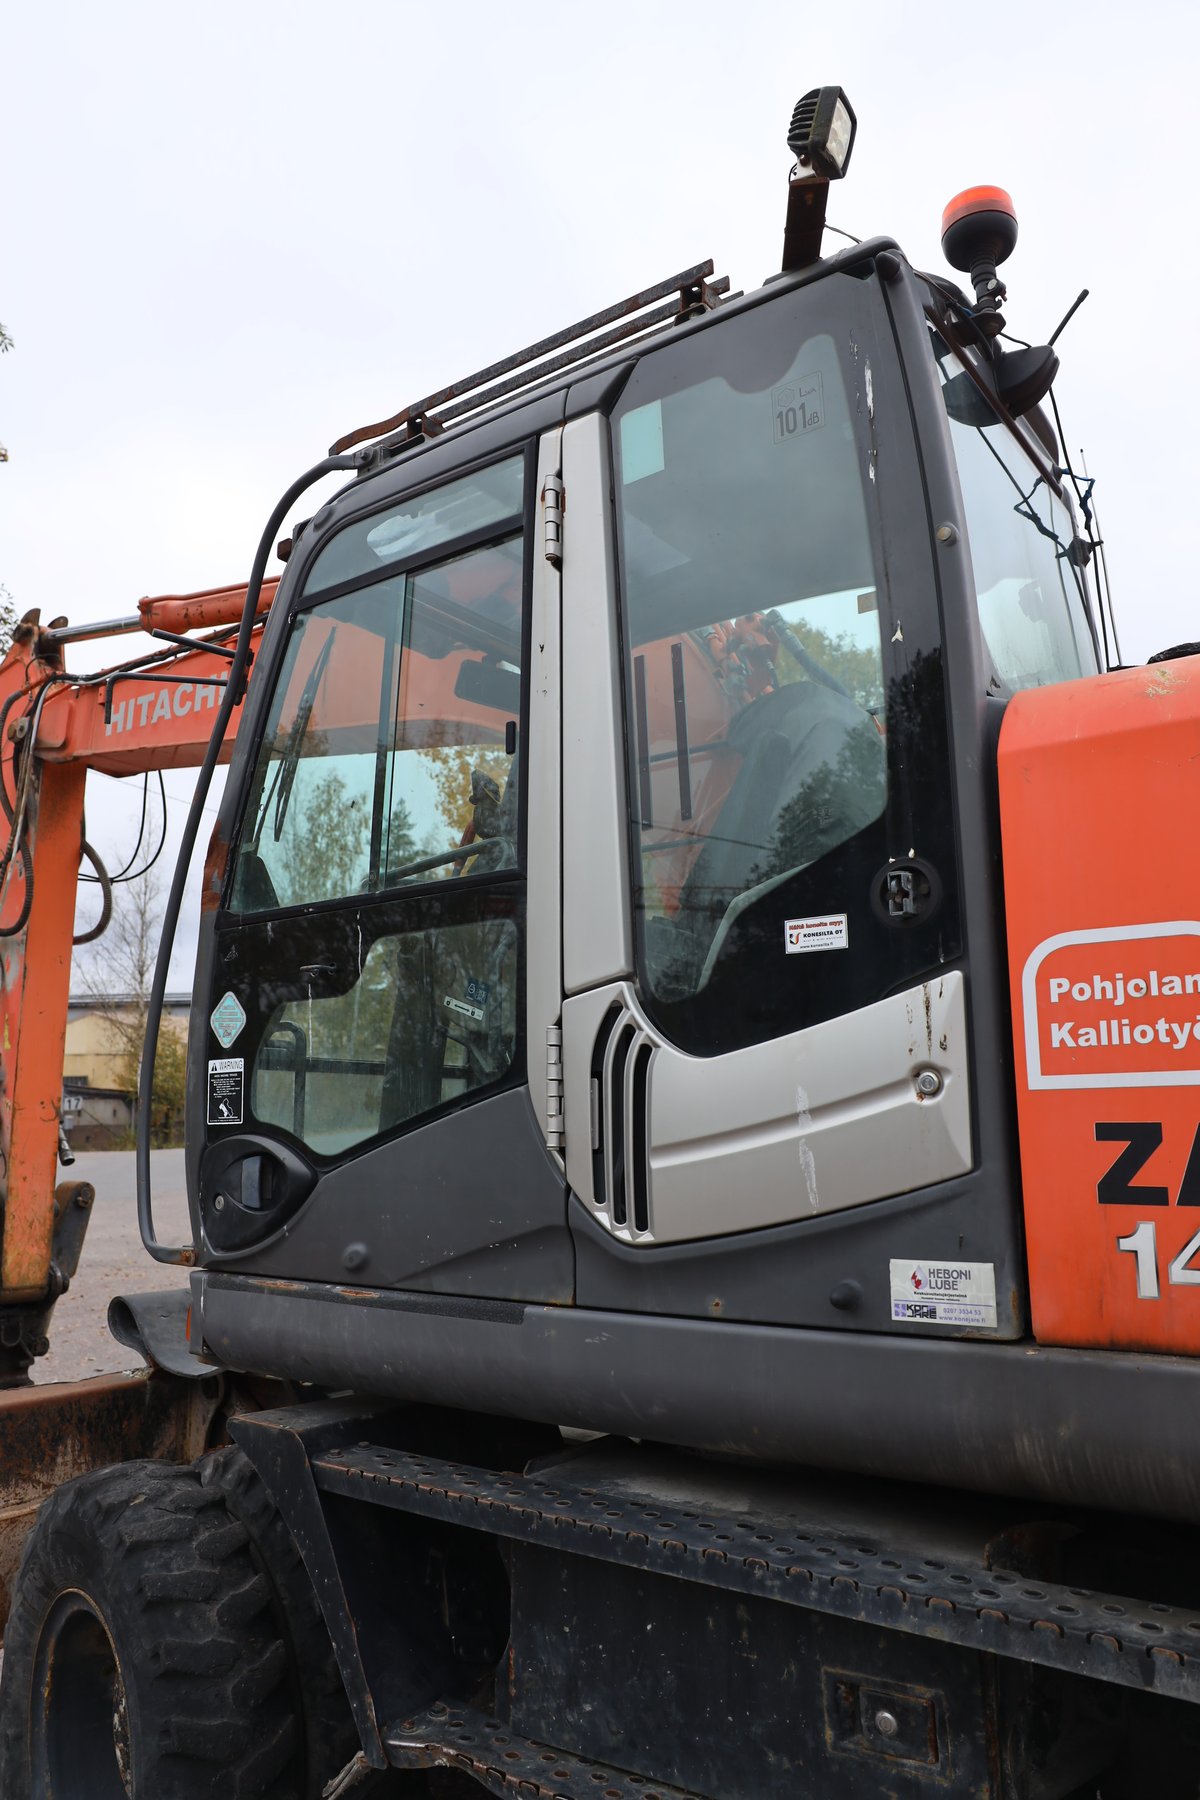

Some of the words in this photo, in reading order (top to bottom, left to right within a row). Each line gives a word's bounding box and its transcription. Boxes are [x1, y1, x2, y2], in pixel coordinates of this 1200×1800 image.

[776, 402, 807, 437] 101
[807, 411, 820, 426] dB
[105, 671, 229, 736] HITACHI
[219, 1059, 243, 1071] WARNING
[928, 1268, 971, 1280] HEBONI
[928, 1279, 959, 1291] LUBE
